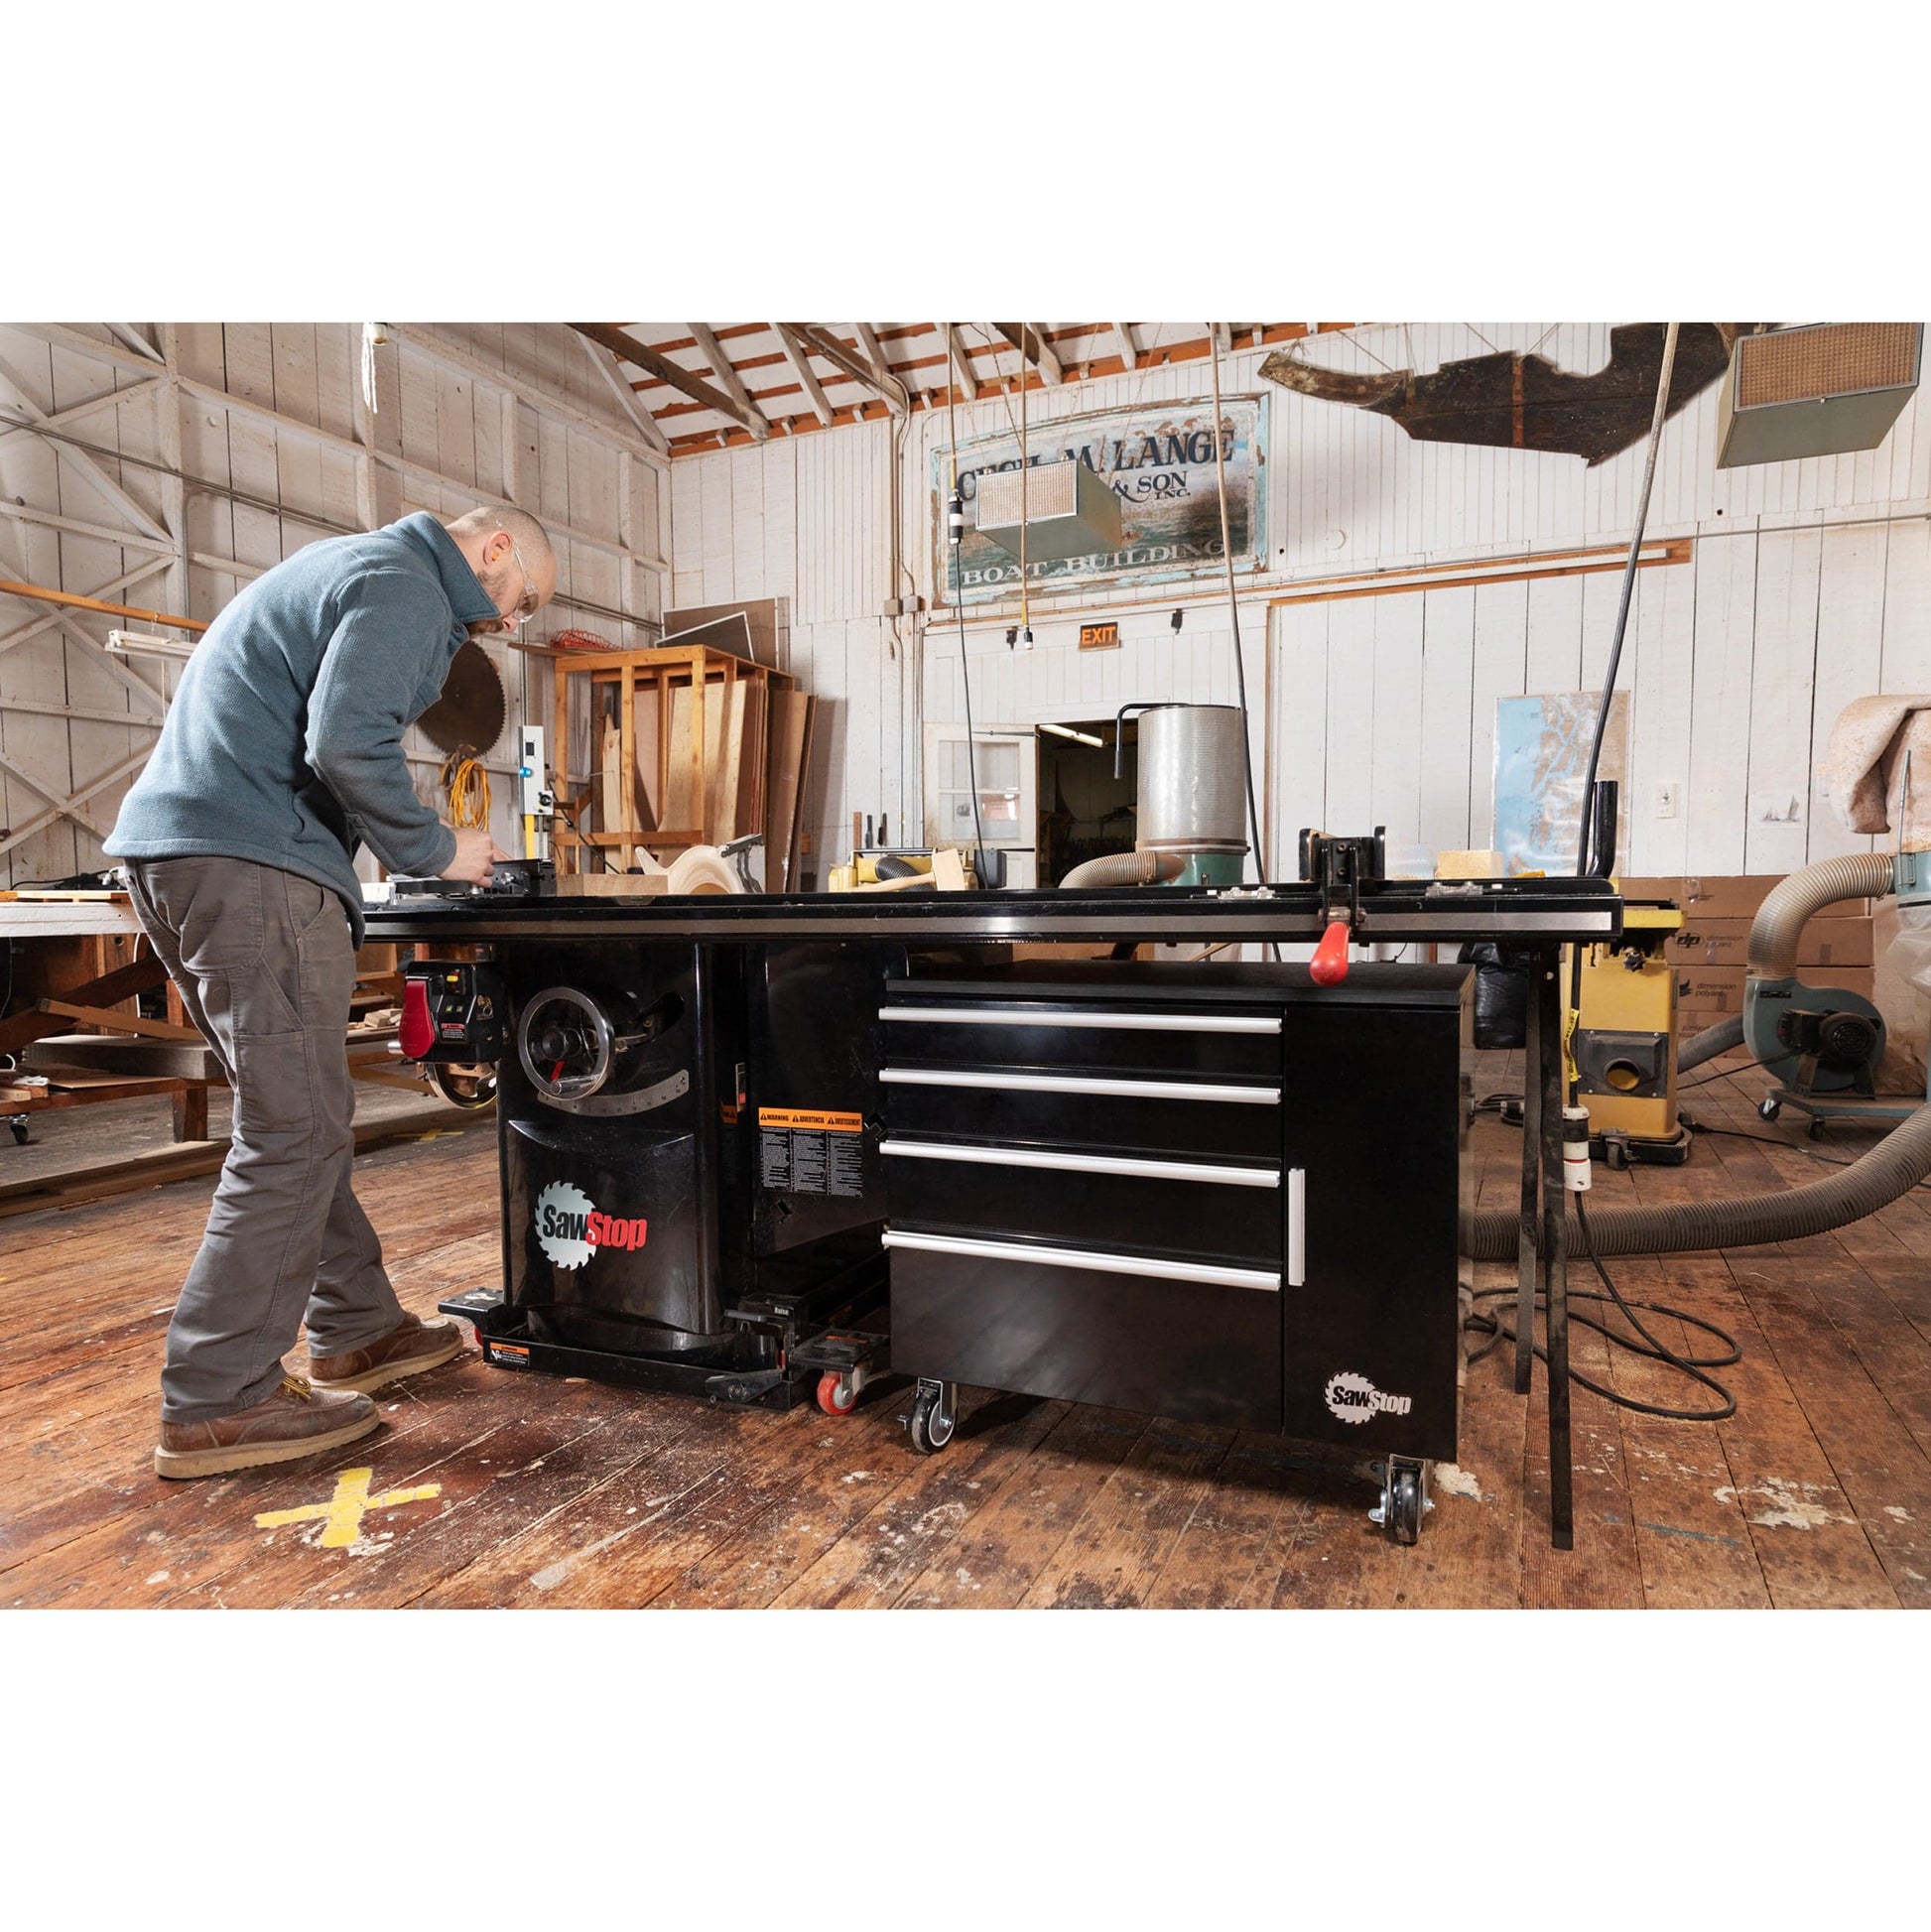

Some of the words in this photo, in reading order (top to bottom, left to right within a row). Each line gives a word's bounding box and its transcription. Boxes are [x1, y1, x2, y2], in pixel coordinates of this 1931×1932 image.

[1112, 429, 1234, 471] LANGE
[1112, 479, 1148, 503] &
[1136, 470, 1188, 494] SON
[1154, 488, 1191, 500] INC.
[963, 561, 1049, 585] BOAT
[1065, 539, 1225, 572] BUILDING
[1081, 626, 1116, 645] EXIT
[543, 1204, 648, 1251] SawStop
[1332, 1385, 1412, 1416] SawStop
